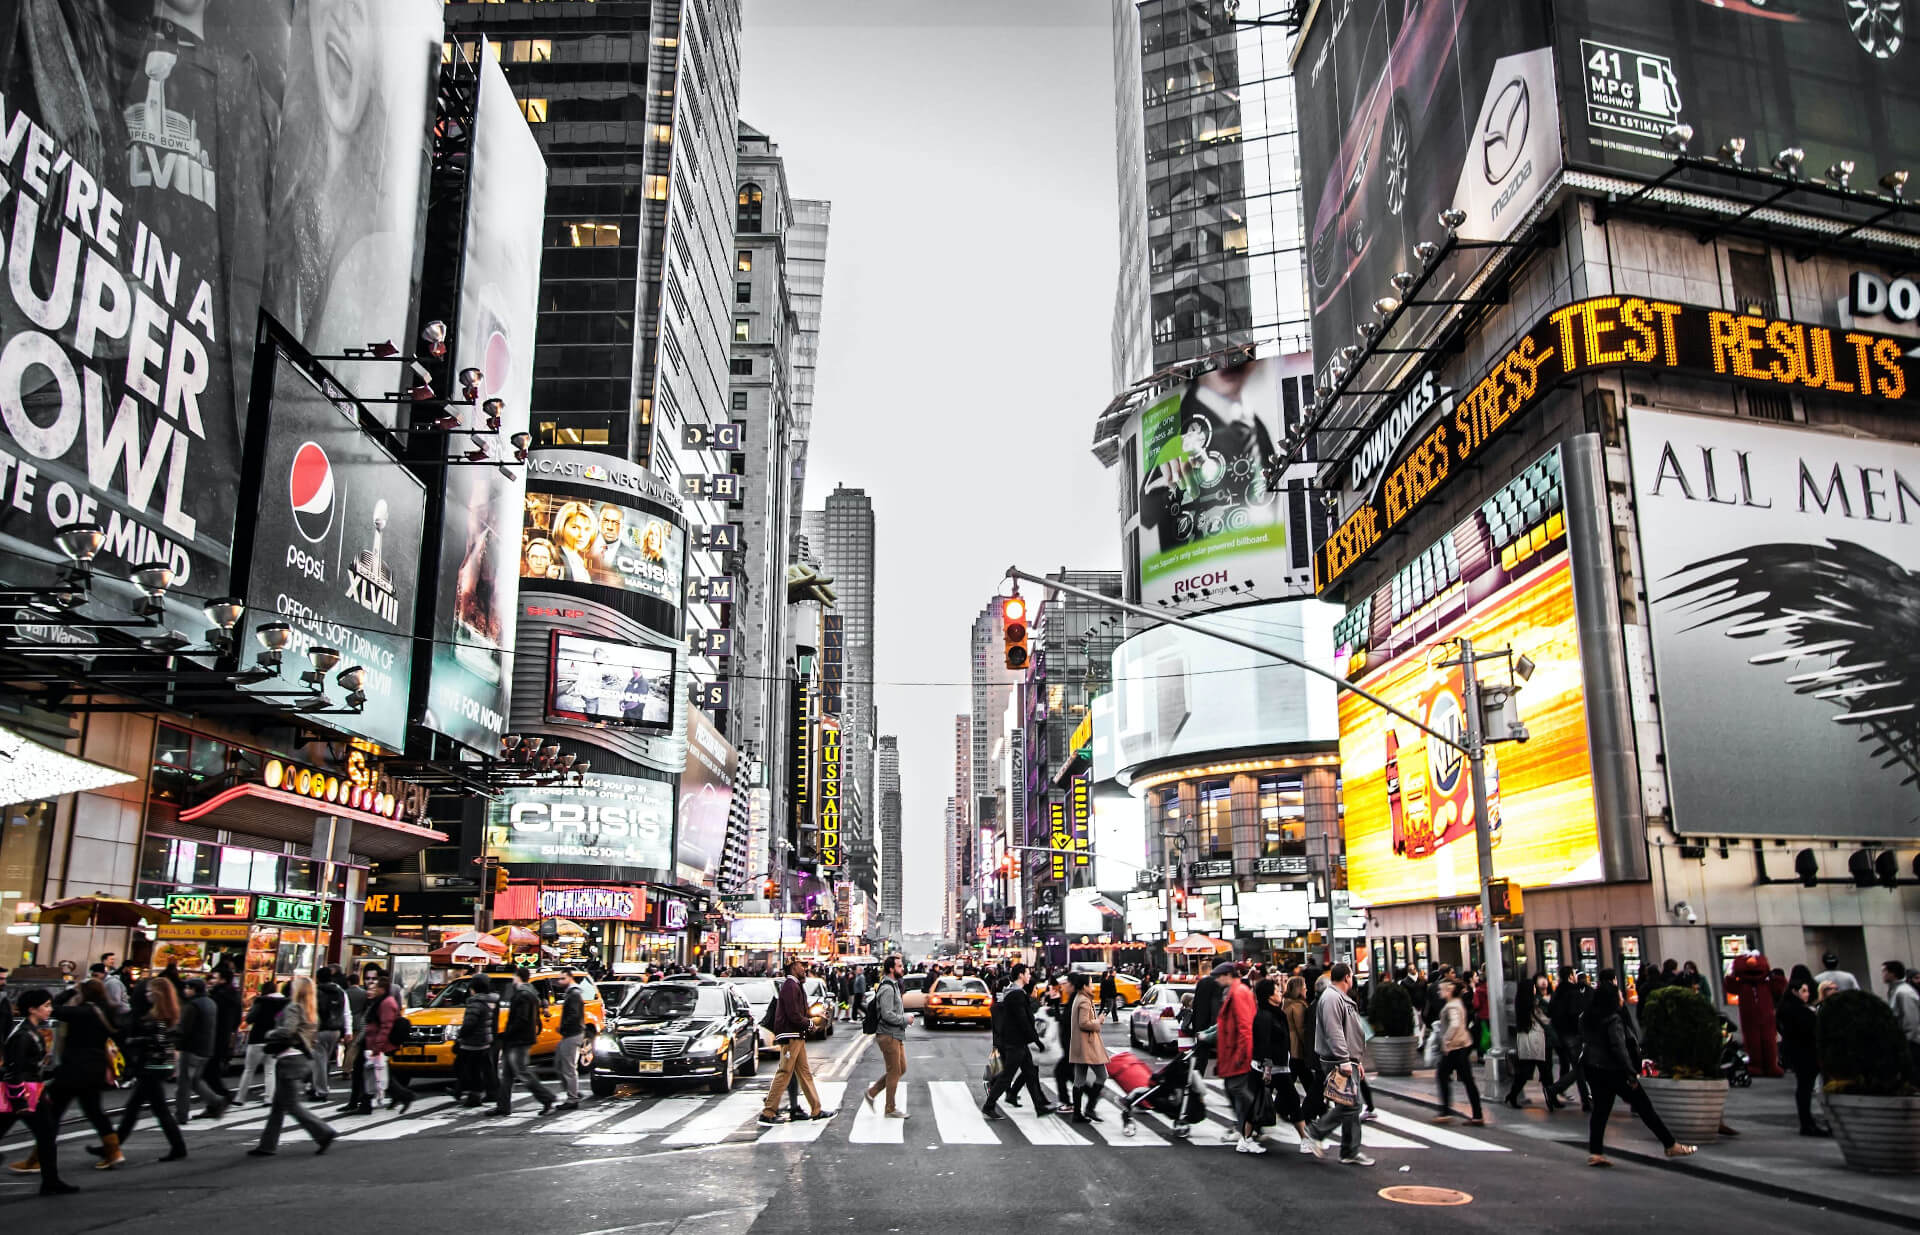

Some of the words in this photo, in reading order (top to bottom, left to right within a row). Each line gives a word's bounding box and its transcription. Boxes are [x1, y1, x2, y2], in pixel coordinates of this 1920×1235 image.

[1588, 49, 1622, 80] 41
[1591, 76, 1634, 99] MPG
[1593, 93, 1634, 109] HIGHWAY
[1595, 111, 1617, 125] EPA
[160, 136, 191, 151] BOWL
[1491, 159, 1532, 222] mazda
[132, 219, 182, 309] IN
[186, 278, 217, 343] A
[1351, 424, 1386, 491] DOW
[1384, 370, 1435, 464] JONES
[1326, 502, 1382, 584] RESERVE
[1384, 424, 1449, 529] REVISES
[1708, 310, 1906, 400] RESULTS
[1647, 439, 1772, 509] ALL
[47, 481, 98, 530] OF
[104, 510, 191, 587] MIND
[286, 544, 325, 582] pepsi
[617, 556, 678, 588] CRISIS
[345, 568, 399, 626] XLVIII
[1174, 569, 1229, 594] RICOH
[526, 605, 585, 619] SHARP
[276, 593, 324, 637] OFFICIAL
[325, 619, 353, 649] SOFT
[352, 635, 381, 666] DRINK
[380, 650, 394, 672] OF
[461, 694, 481, 723] FOR
[480, 705, 504, 734] NOW
[1011, 729, 1024, 748] NEW
[348, 750, 432, 827] Subway
[577, 788, 597, 797] the
[1074, 778, 1089, 832] VICTORY
[510, 802, 660, 841] CRISIS
[541, 845, 598, 857] SUNDAYS
[1053, 855, 1065, 879] NEW
[275, 901, 313, 922] RICE
[540, 888, 634, 918] CHAMPS
[160, 928, 198, 937] HALAL
[211, 928, 249, 937] FOOD
